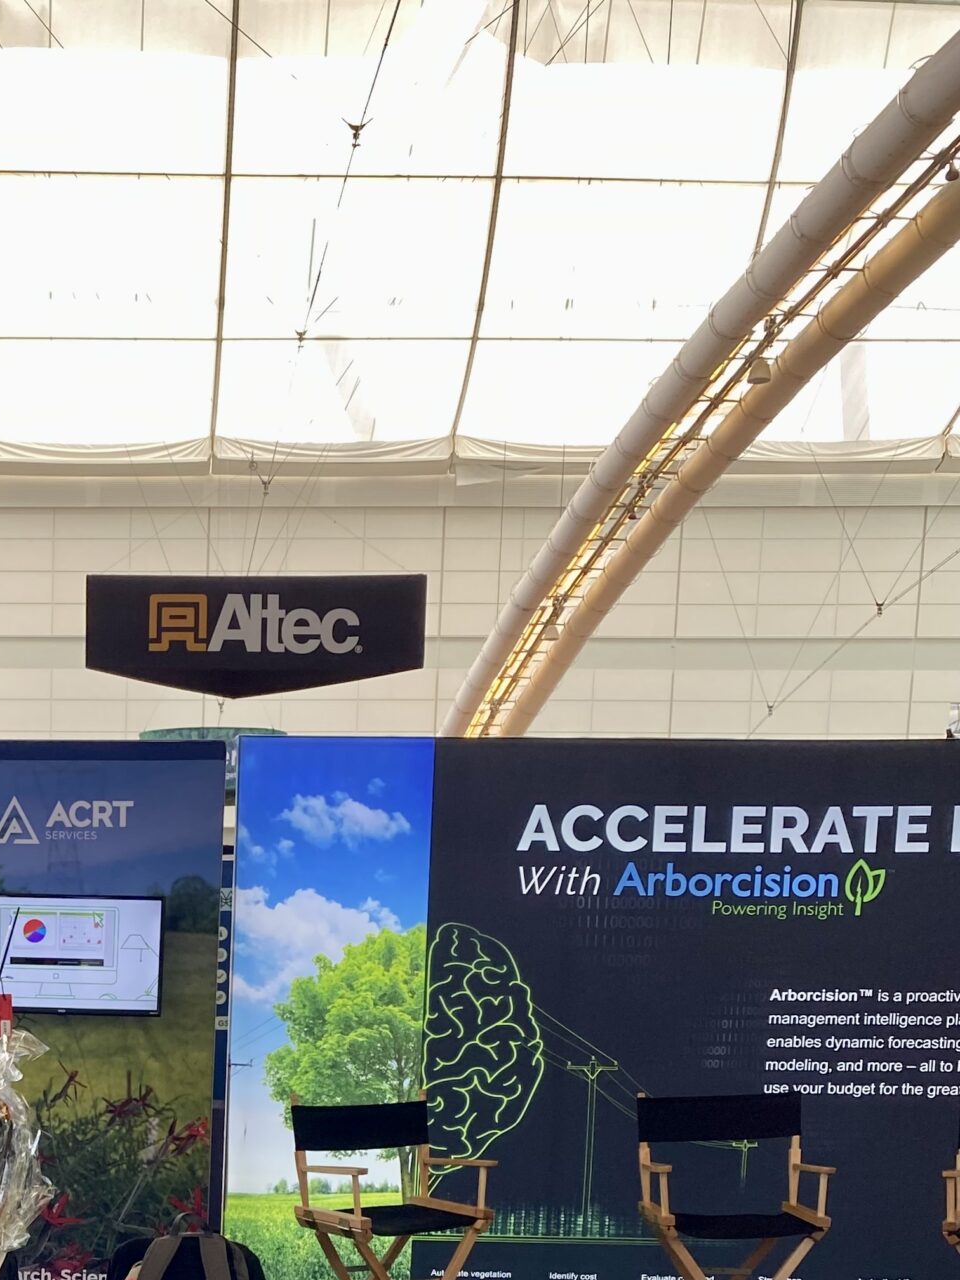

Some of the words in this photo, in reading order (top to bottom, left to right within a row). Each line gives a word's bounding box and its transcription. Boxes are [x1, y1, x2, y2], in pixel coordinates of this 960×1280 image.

[45, 800, 134, 828] ACRT
[45, 831, 98, 840] SERVICES
[516, 804, 931, 853] ACCELERATE
[517, 865, 601, 896] With
[613, 862, 839, 898] Arborcision
[711, 900, 787, 920] Powering
[792, 900, 844, 920] Insight
[878, 989, 889, 1002] is
[893, 992, 902, 1002] a
[768, 1013, 860, 1027] management
[863, 1013, 942, 1028] intelligence
[766, 1036, 822, 1048] enables
[825, 1036, 884, 1051] dynamic
[765, 1059, 832, 1074] modeling,
[836, 1060, 863, 1072] and
[867, 1062, 903, 1072] more
[919, 1060, 936, 1072] all
[940, 1061, 953, 1072] to
[763, 1084, 789, 1095] use
[827, 1083, 876, 1098] budget
[879, 1083, 898, 1095] for
[902, 1083, 923, 1095] the
[471, 1271, 512, 1279] vegetation
[580, 1273, 597, 1280] cost
